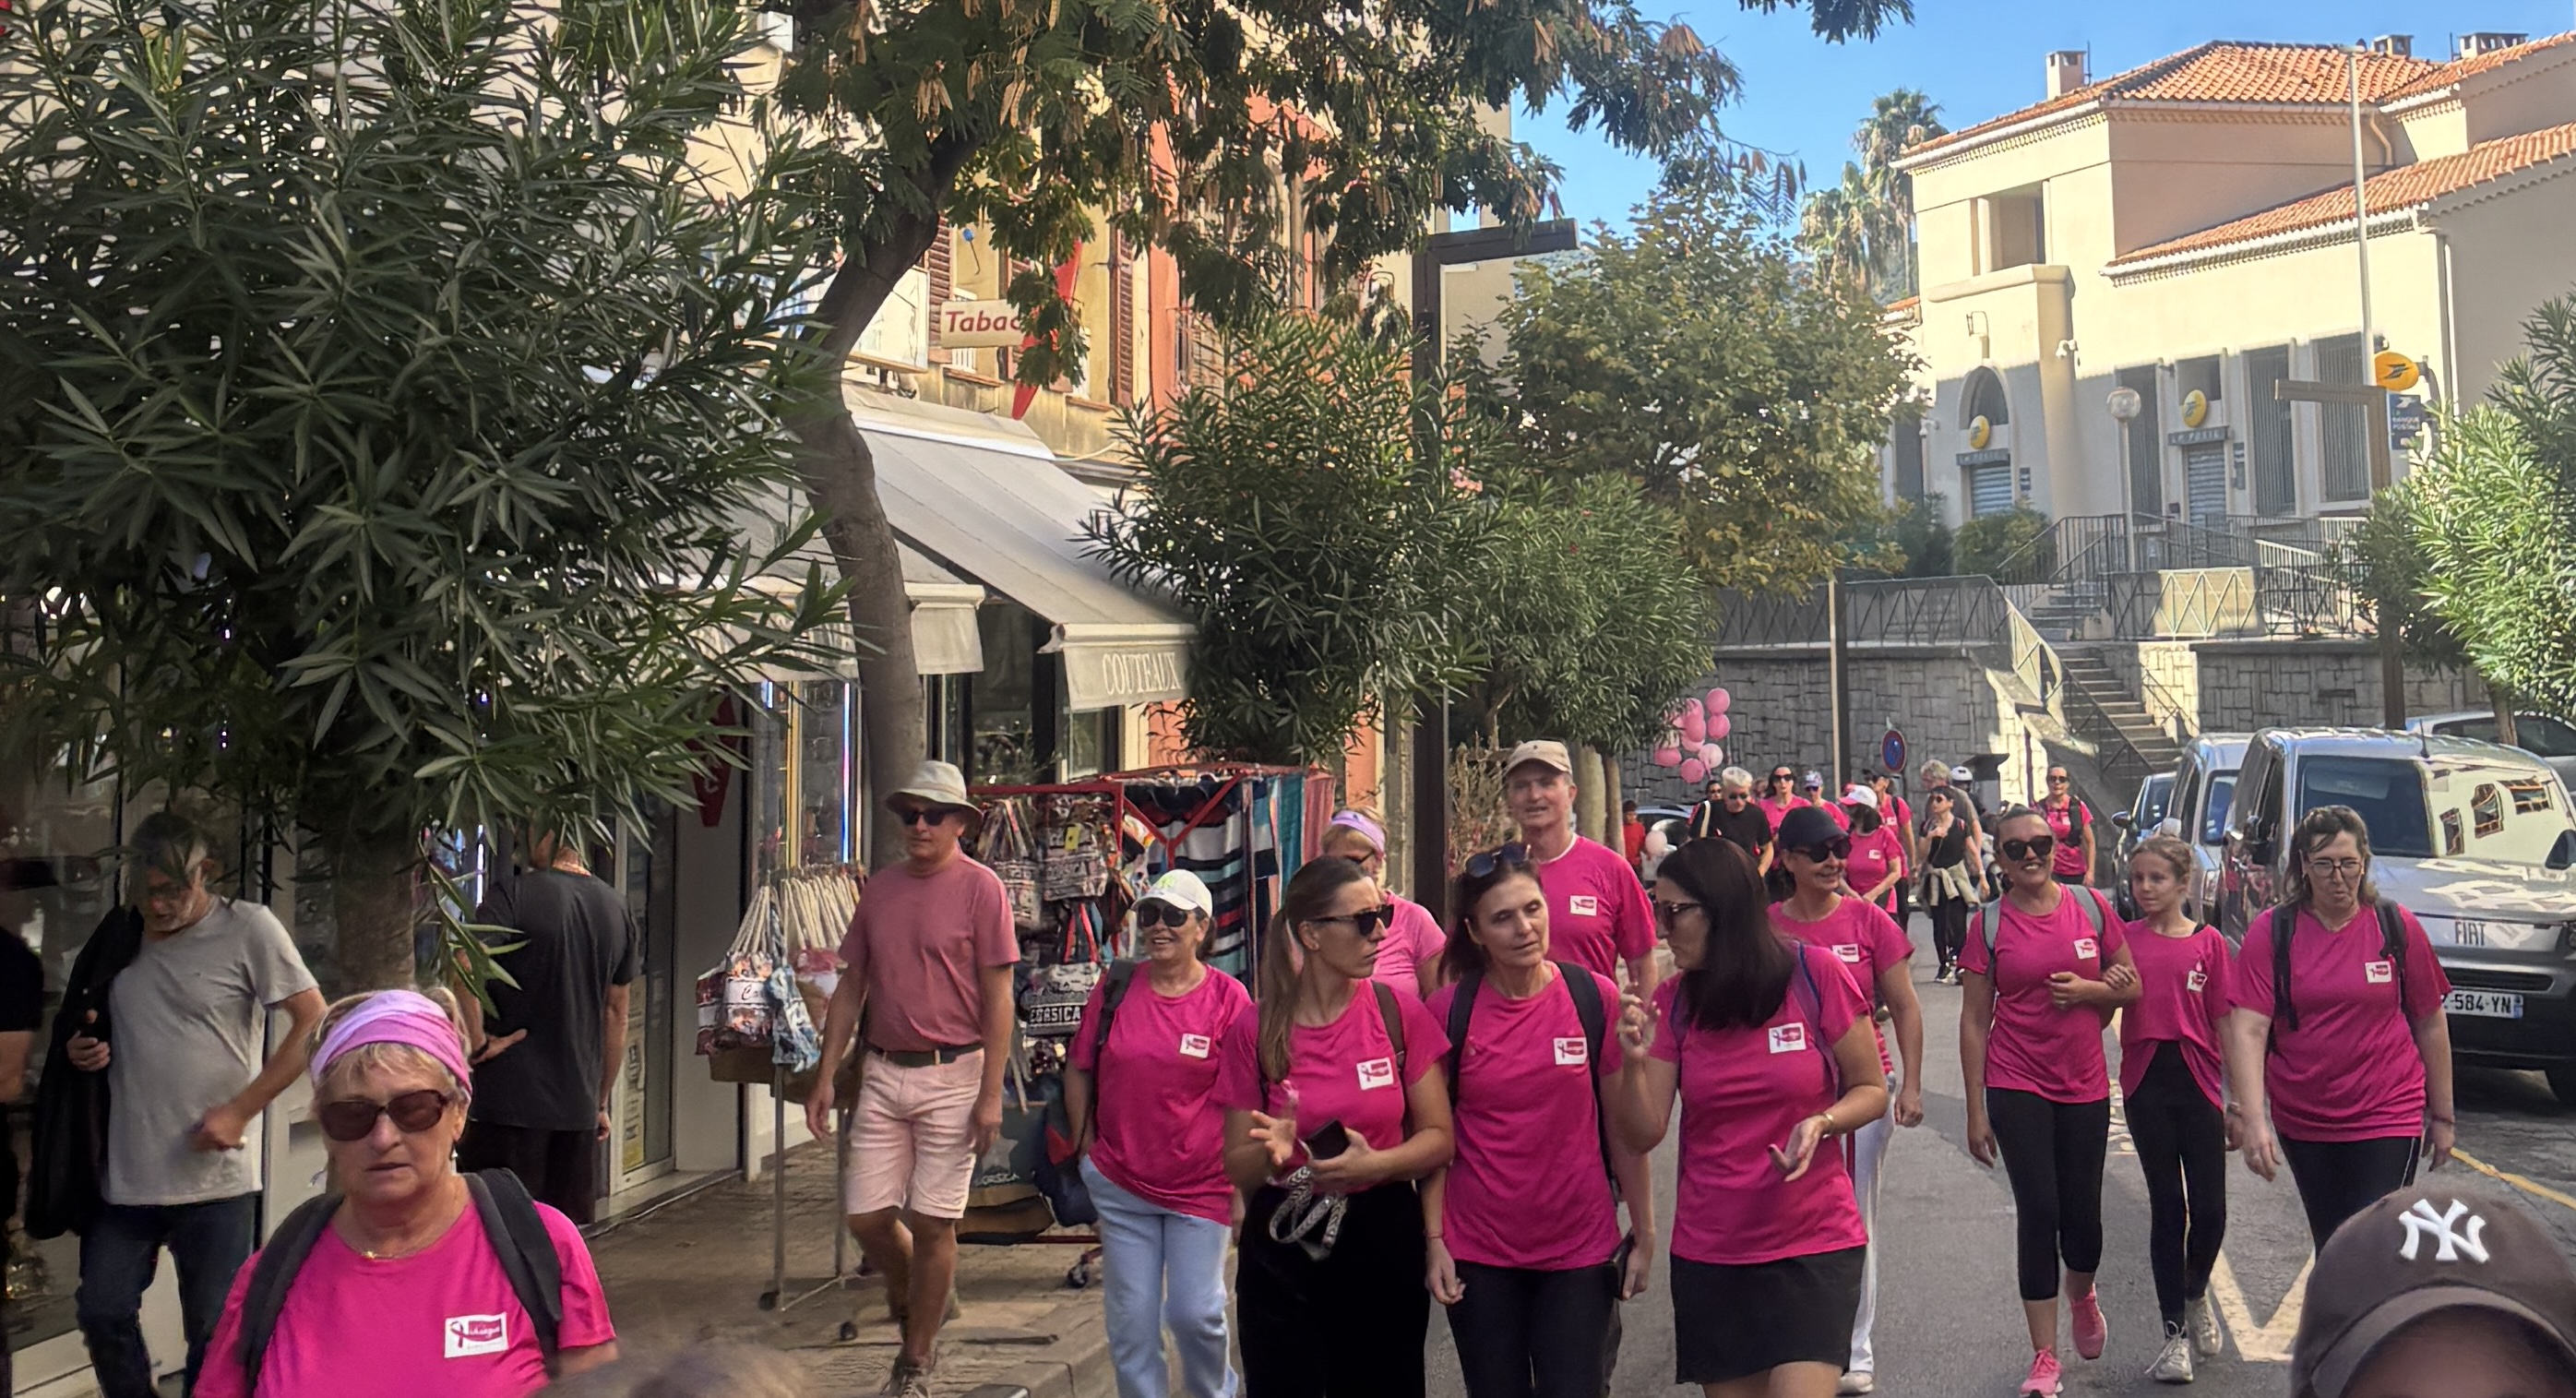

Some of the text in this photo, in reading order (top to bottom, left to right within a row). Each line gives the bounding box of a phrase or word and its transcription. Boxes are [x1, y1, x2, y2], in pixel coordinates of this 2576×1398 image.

[1102, 651, 1182, 696] COUTEAUX
[2454, 921, 2486, 947] FIAT
[2399, 1199, 2490, 1264] NY
